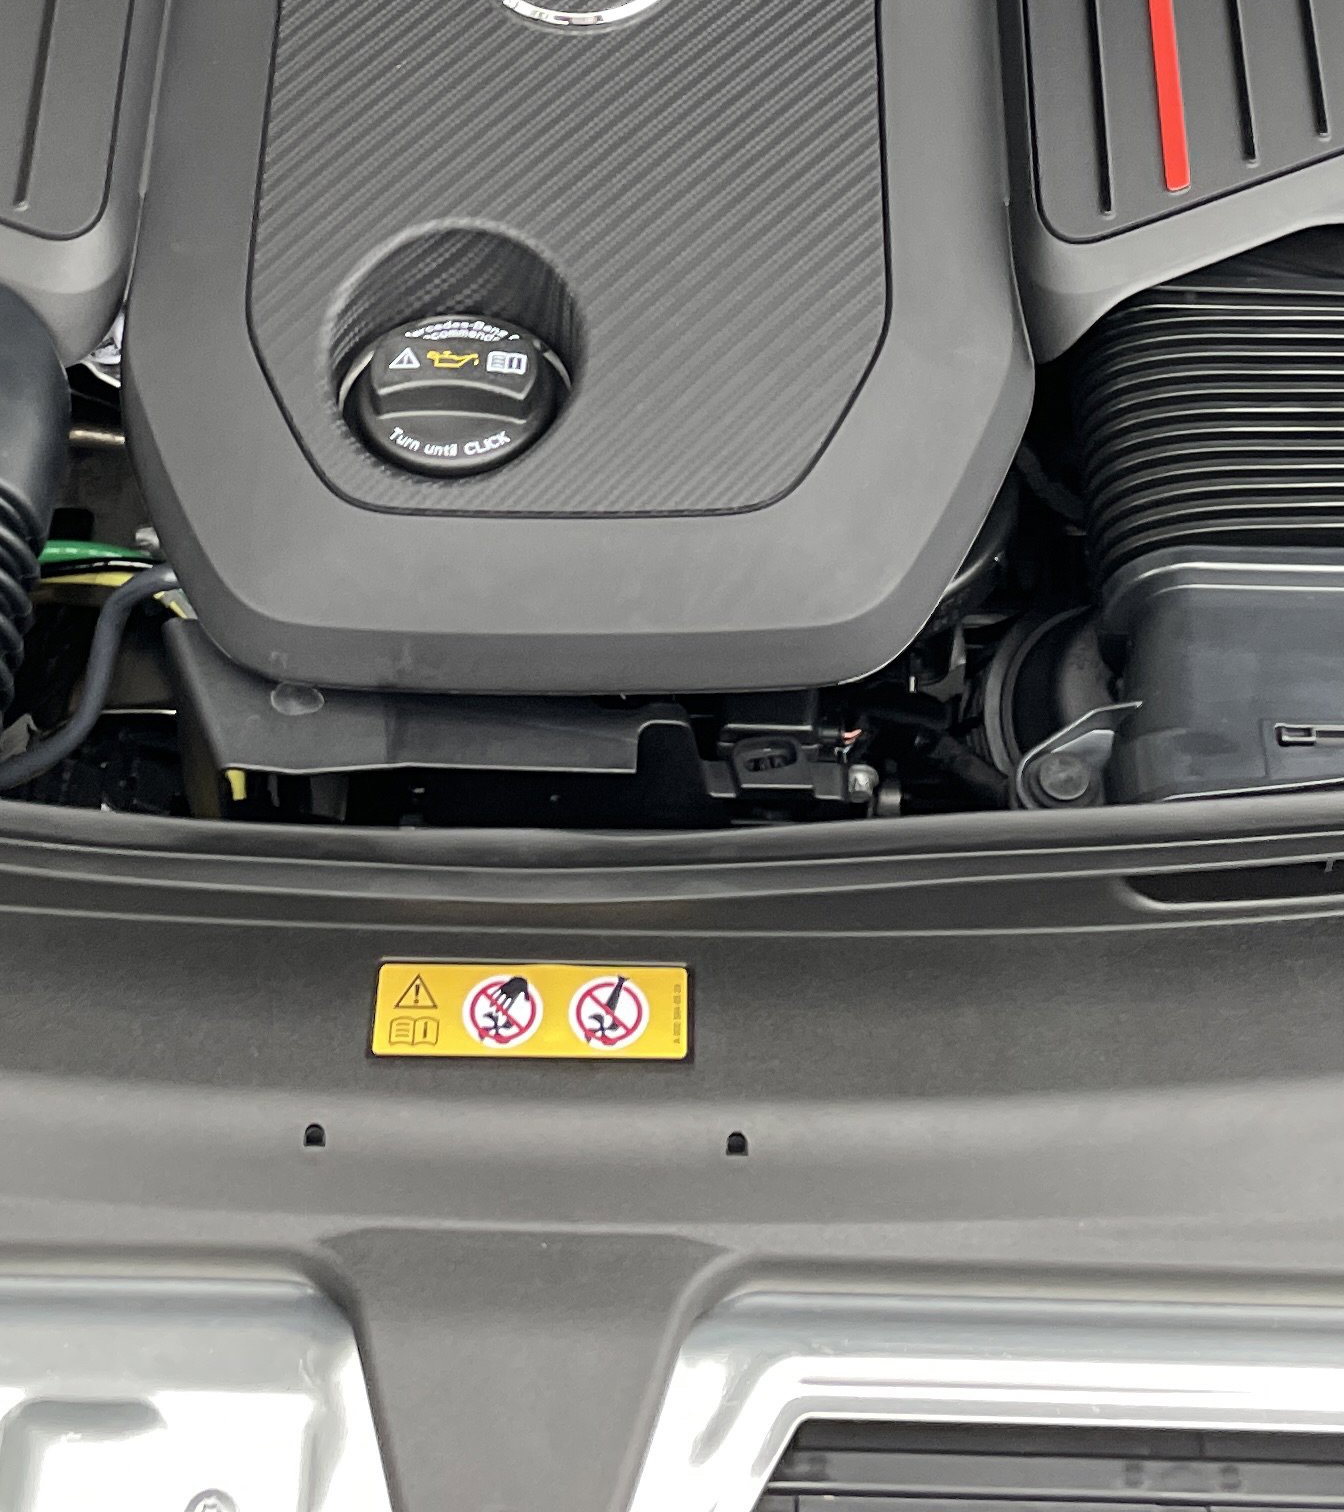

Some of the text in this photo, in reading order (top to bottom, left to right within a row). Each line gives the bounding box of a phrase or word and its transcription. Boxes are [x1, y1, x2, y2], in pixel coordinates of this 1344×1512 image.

[389, 426, 511, 457] Turn until CLICK
